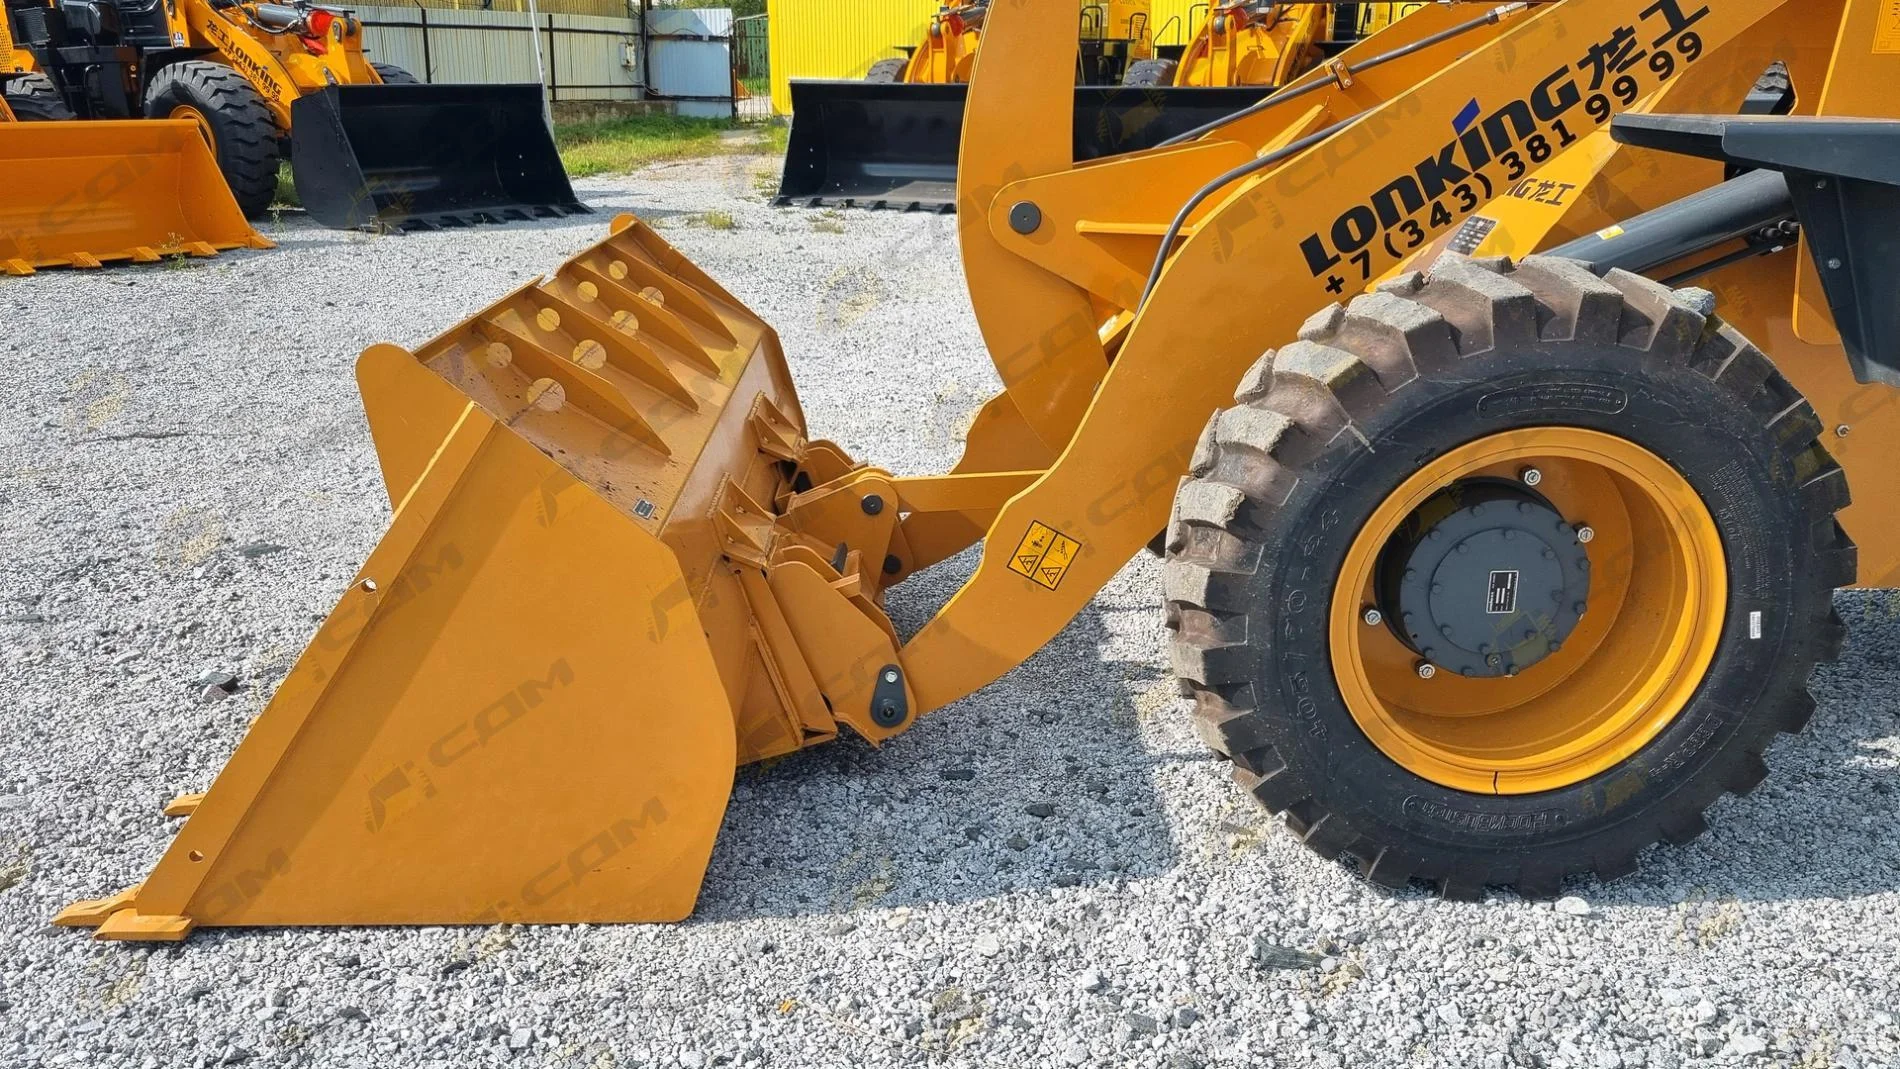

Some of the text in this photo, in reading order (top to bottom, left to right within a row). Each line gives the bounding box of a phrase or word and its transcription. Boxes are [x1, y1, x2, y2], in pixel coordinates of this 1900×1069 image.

[1500, 118, 1577, 181] 381
[1584, 74, 1639, 125] 99
[1648, 31, 1703, 82] 99
